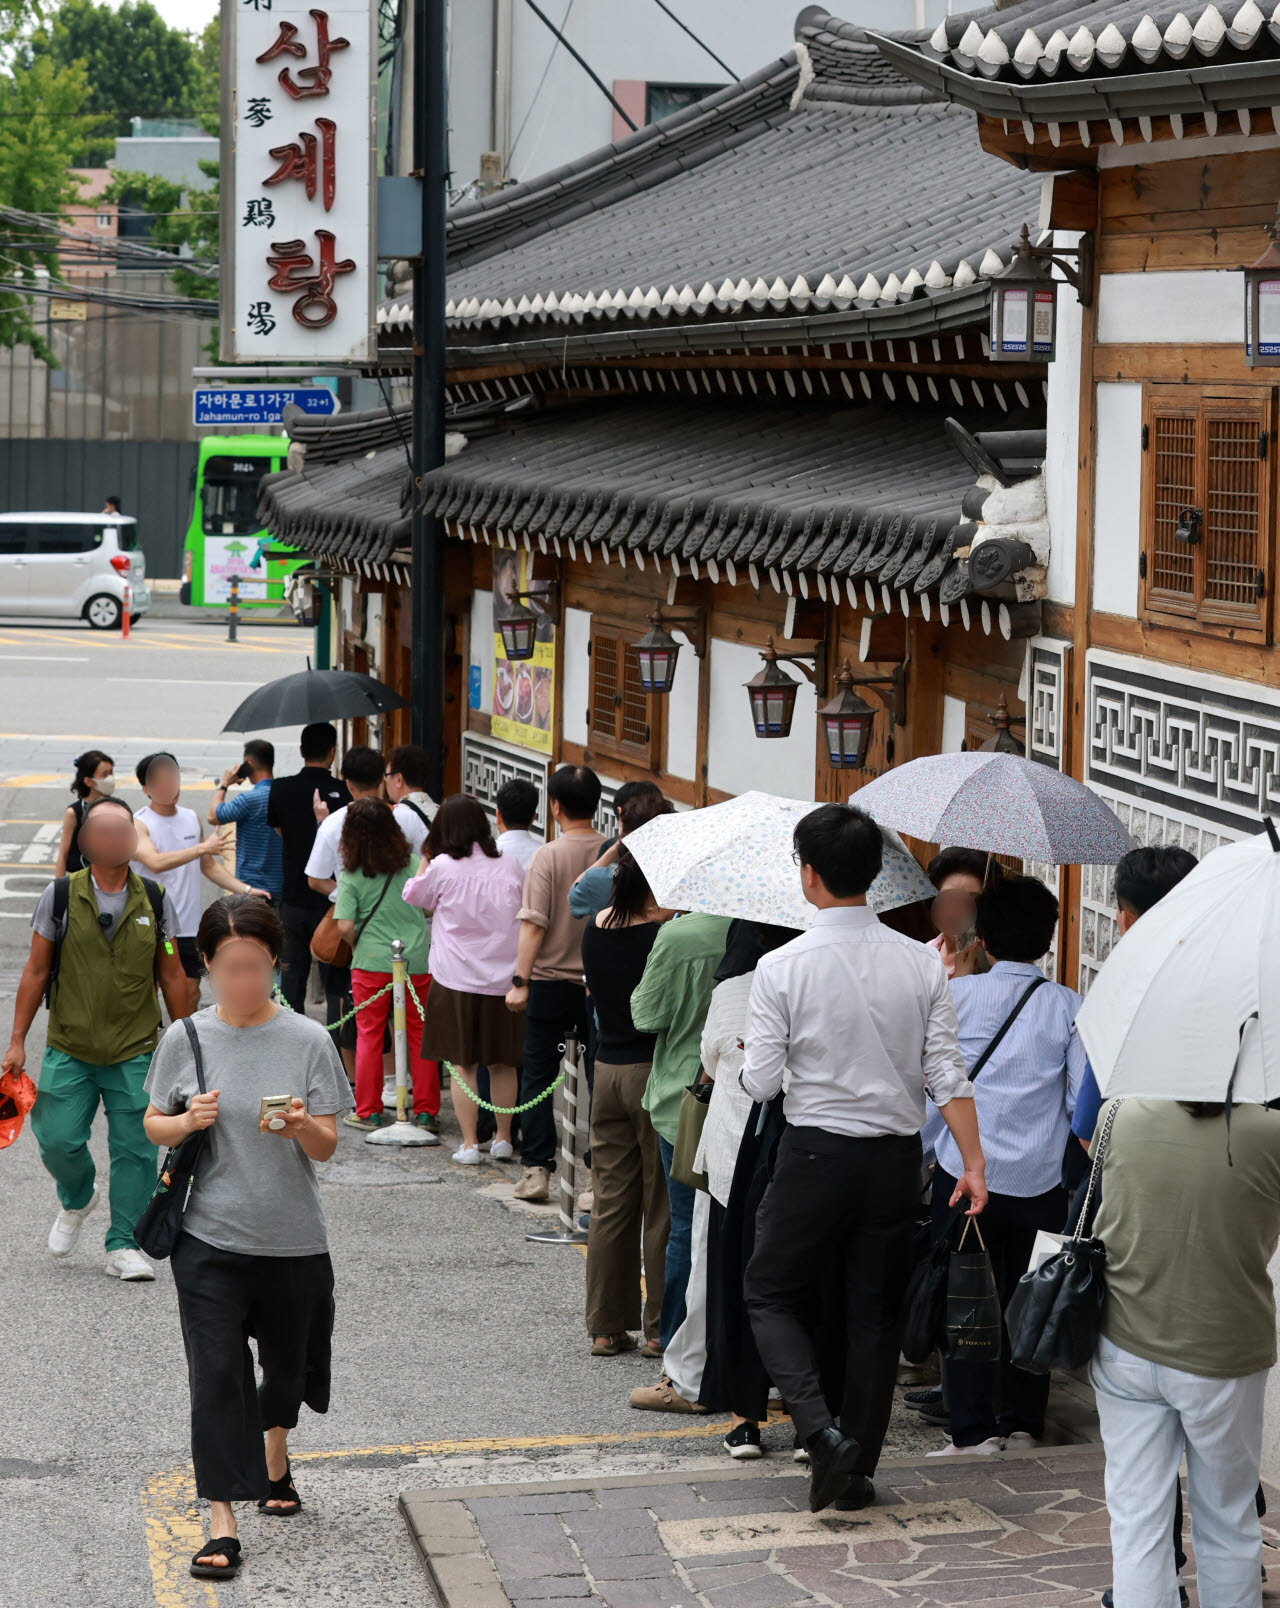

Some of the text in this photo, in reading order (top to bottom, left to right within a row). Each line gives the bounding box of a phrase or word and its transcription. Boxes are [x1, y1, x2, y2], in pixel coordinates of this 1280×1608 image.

[256, 9, 356, 328] 삼계탕
[199, 393, 295, 409] 자하문로1가길
[199, 411, 260, 422] Jahamun-ro
